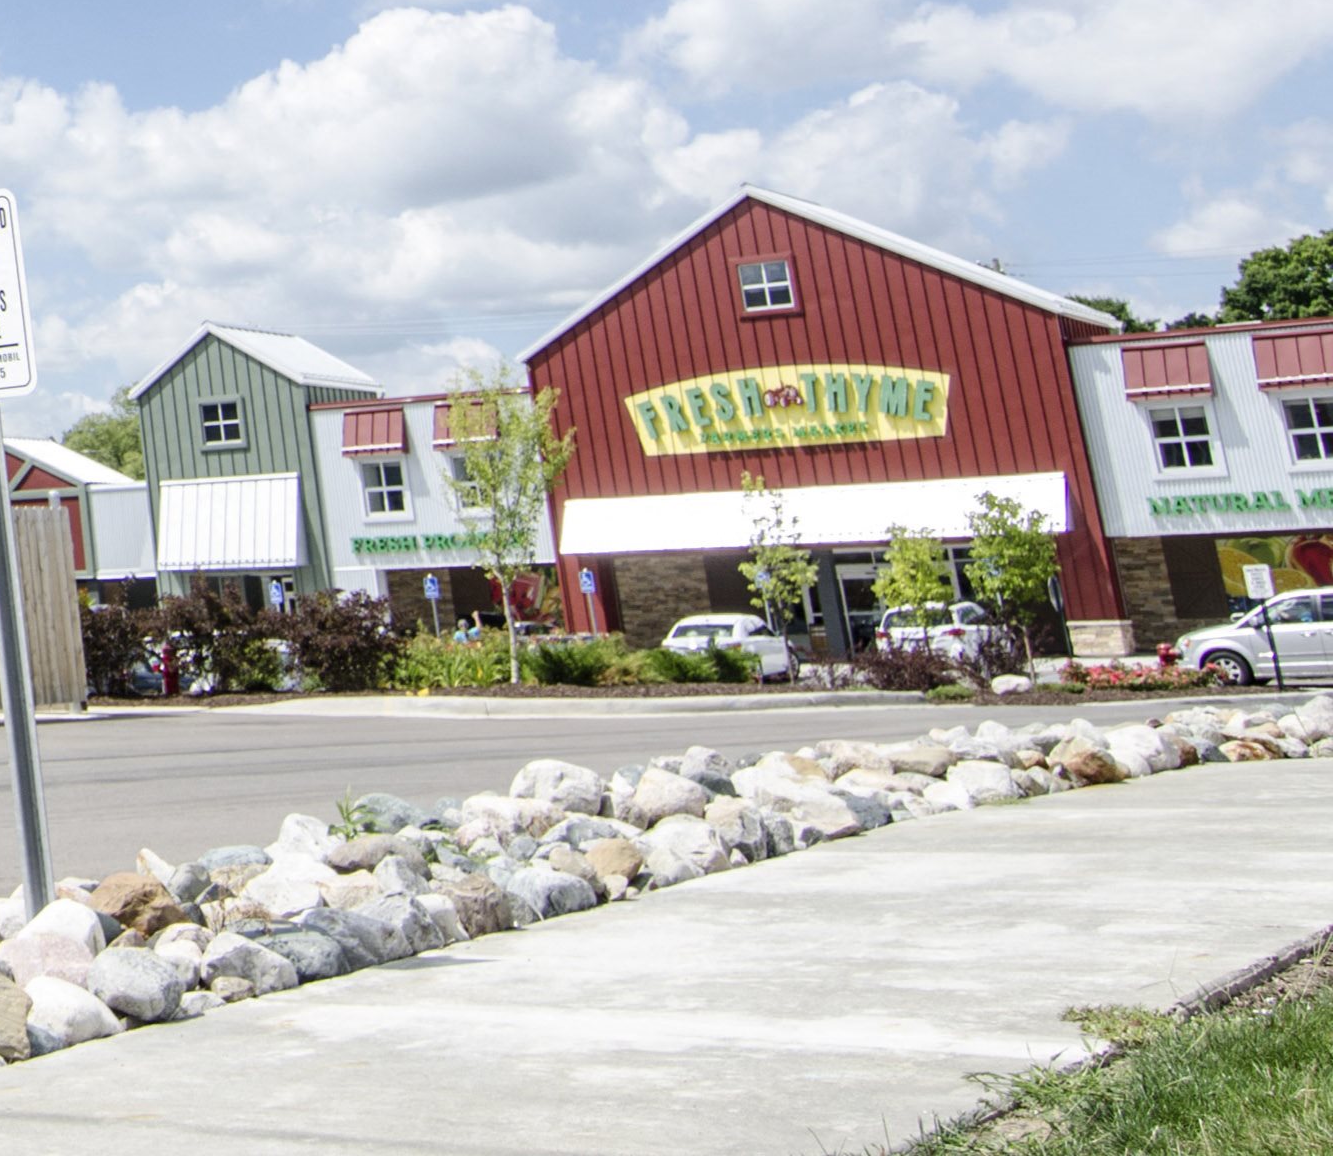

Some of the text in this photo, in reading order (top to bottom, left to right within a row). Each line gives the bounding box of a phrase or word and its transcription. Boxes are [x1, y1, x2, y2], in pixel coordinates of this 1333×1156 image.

[635, 371, 938, 442] FRESH THYME
[1146, 490, 1292, 515] NATURAL
[350, 534, 419, 555] FRESH
